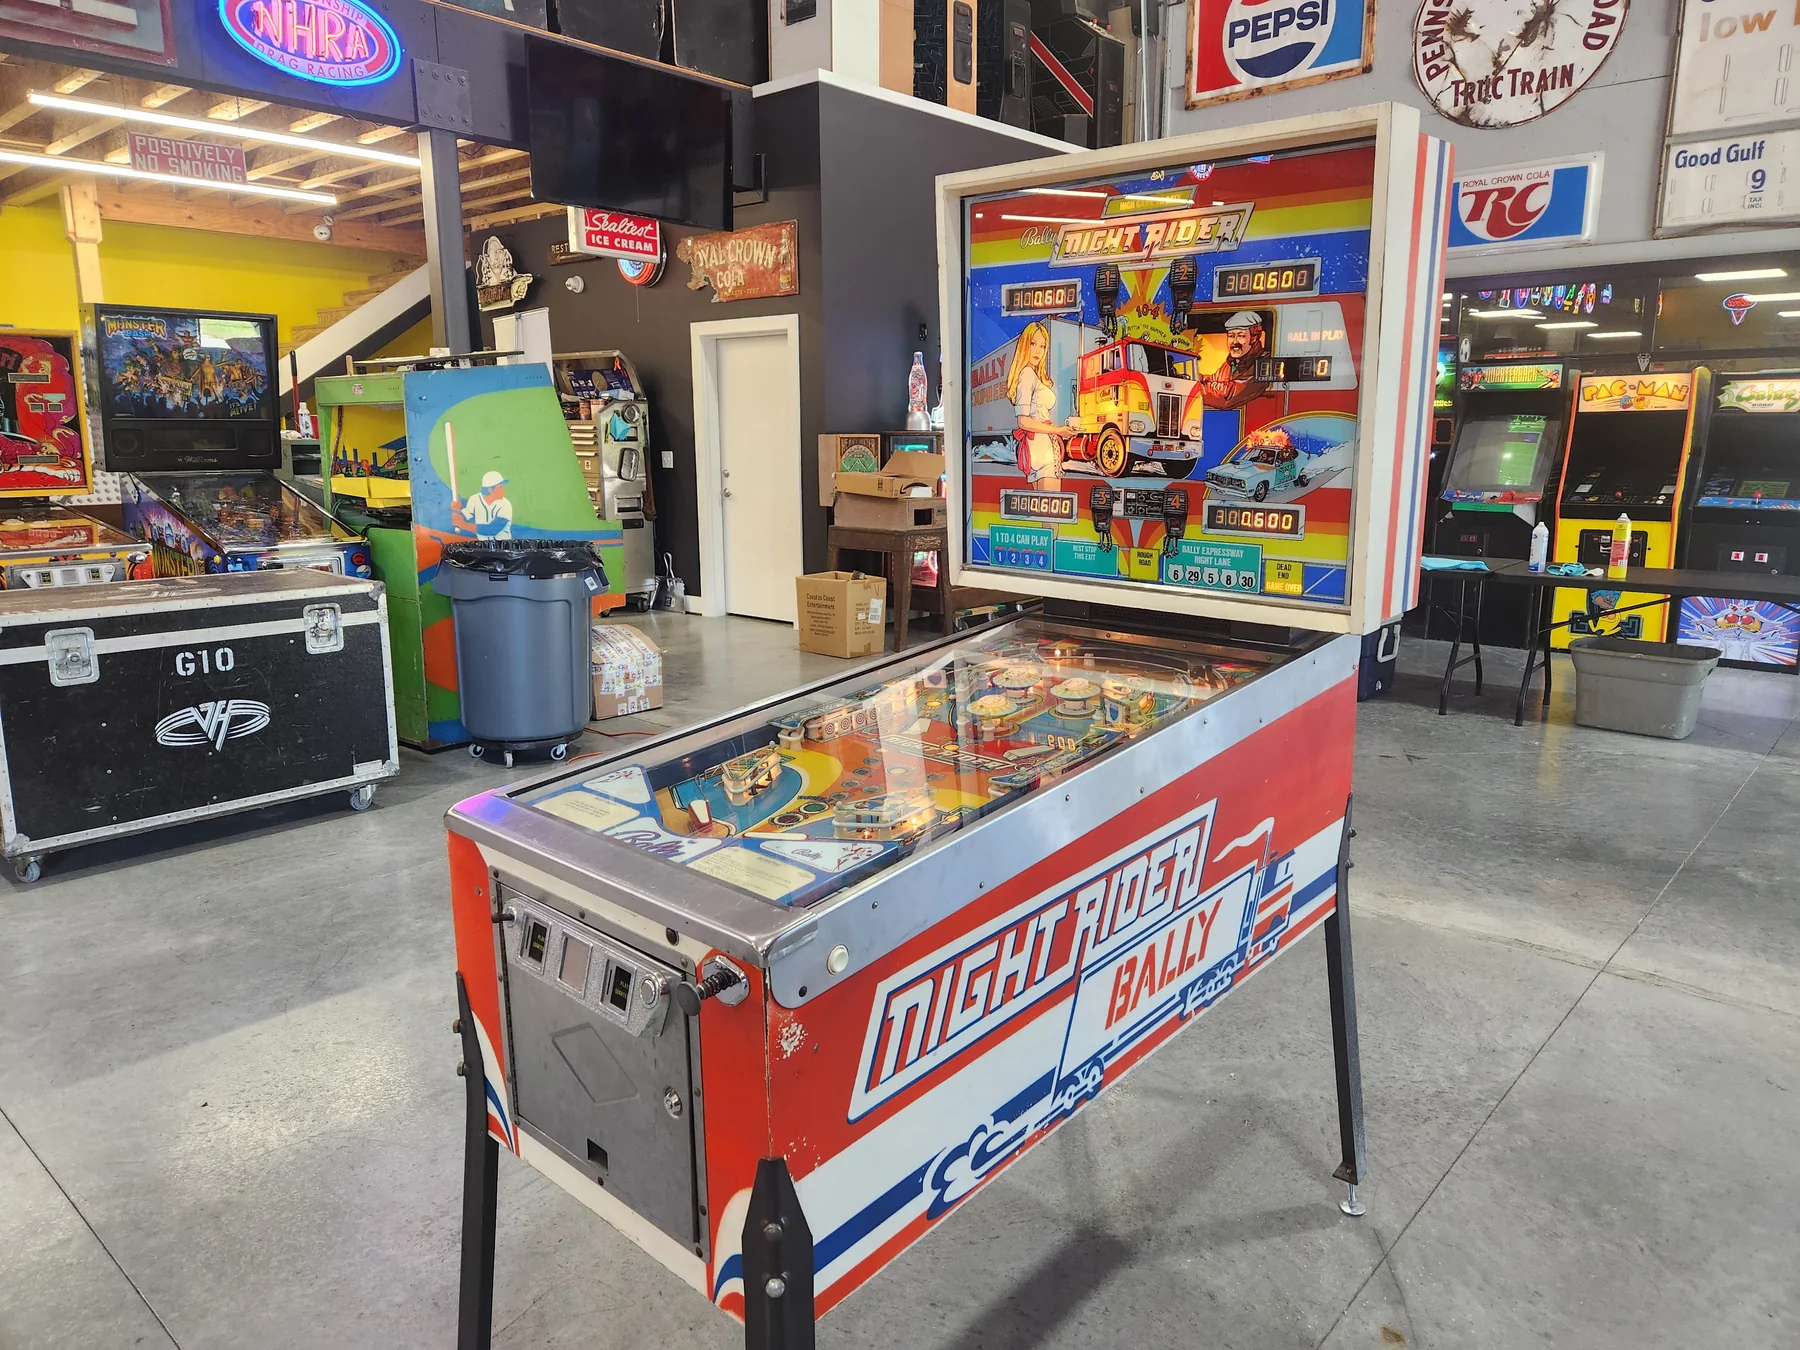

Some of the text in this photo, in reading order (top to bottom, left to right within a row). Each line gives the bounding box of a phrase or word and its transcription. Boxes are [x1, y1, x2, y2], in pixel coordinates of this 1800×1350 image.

[313, 0, 364, 21] NSHIP
[251, 0, 370, 63] NHRA
[1228, 0, 1329, 48] PEPSI
[1699, 9, 1777, 42] low
[256, 43, 364, 78] DRAG RACING
[135, 136, 235, 163] POSITIVELY
[1675, 140, 1765, 169] Good Gulf
[134, 153, 242, 183] NO SMOKING
[1462, 170, 1550, 188] ROYAL CROWN COLA
[1751, 169, 1766, 190] 9
[1120, 201, 1135, 210] HIGH
[1461, 182, 1549, 238] RC
[589, 212, 656, 240] Sealtest
[1062, 212, 1241, 259] NIGHT RIDER
[591, 234, 653, 252] ICE CREAM
[1020, 226, 1058, 249] Bally
[694, 239, 777, 269] OYAL CROWN
[717, 268, 745, 289] COLA
[1105, 270, 1111, 286] 1
[1180, 264, 1189, 280] 2
[1136, 303, 1160, 319] 10-4
[105, 318, 168, 337] MONSTER
[1287, 329, 1344, 342] BALL IN PLAY
[971, 353, 1006, 388] BALLY
[1485, 367, 1538, 384] QUARTERBACK
[1582, 380, 1690, 402] PAC-MAN
[1098, 492, 1107, 505] 3
[1170, 494, 1180, 509] 4
[1000, 533, 1009, 543] TO
[1010, 533, 1015, 544] 4
[1016, 534, 1030, 545] CAN
[1031, 535, 1049, 547] PLAY
[1072, 545, 1097, 553] REST STOP
[1011, 553, 1016, 563] 2
[1024, 554, 1030, 565] 3
[1038, 555, 1044, 566] 4
[1074, 553, 1084, 561] THIS
[1182, 545, 1245, 558] BALLY EXPRESSWAY
[1194, 556, 1231, 566] RIGHT LANE
[1276, 563, 1292, 571] DEAD
[1173, 570, 1253, 588] 6 29 5 8 30
[1266, 582, 1302, 593] GAME OVER
[880, 825, 1202, 1085] NIGHT RIDER
[1105, 895, 1223, 1030] BALLY
